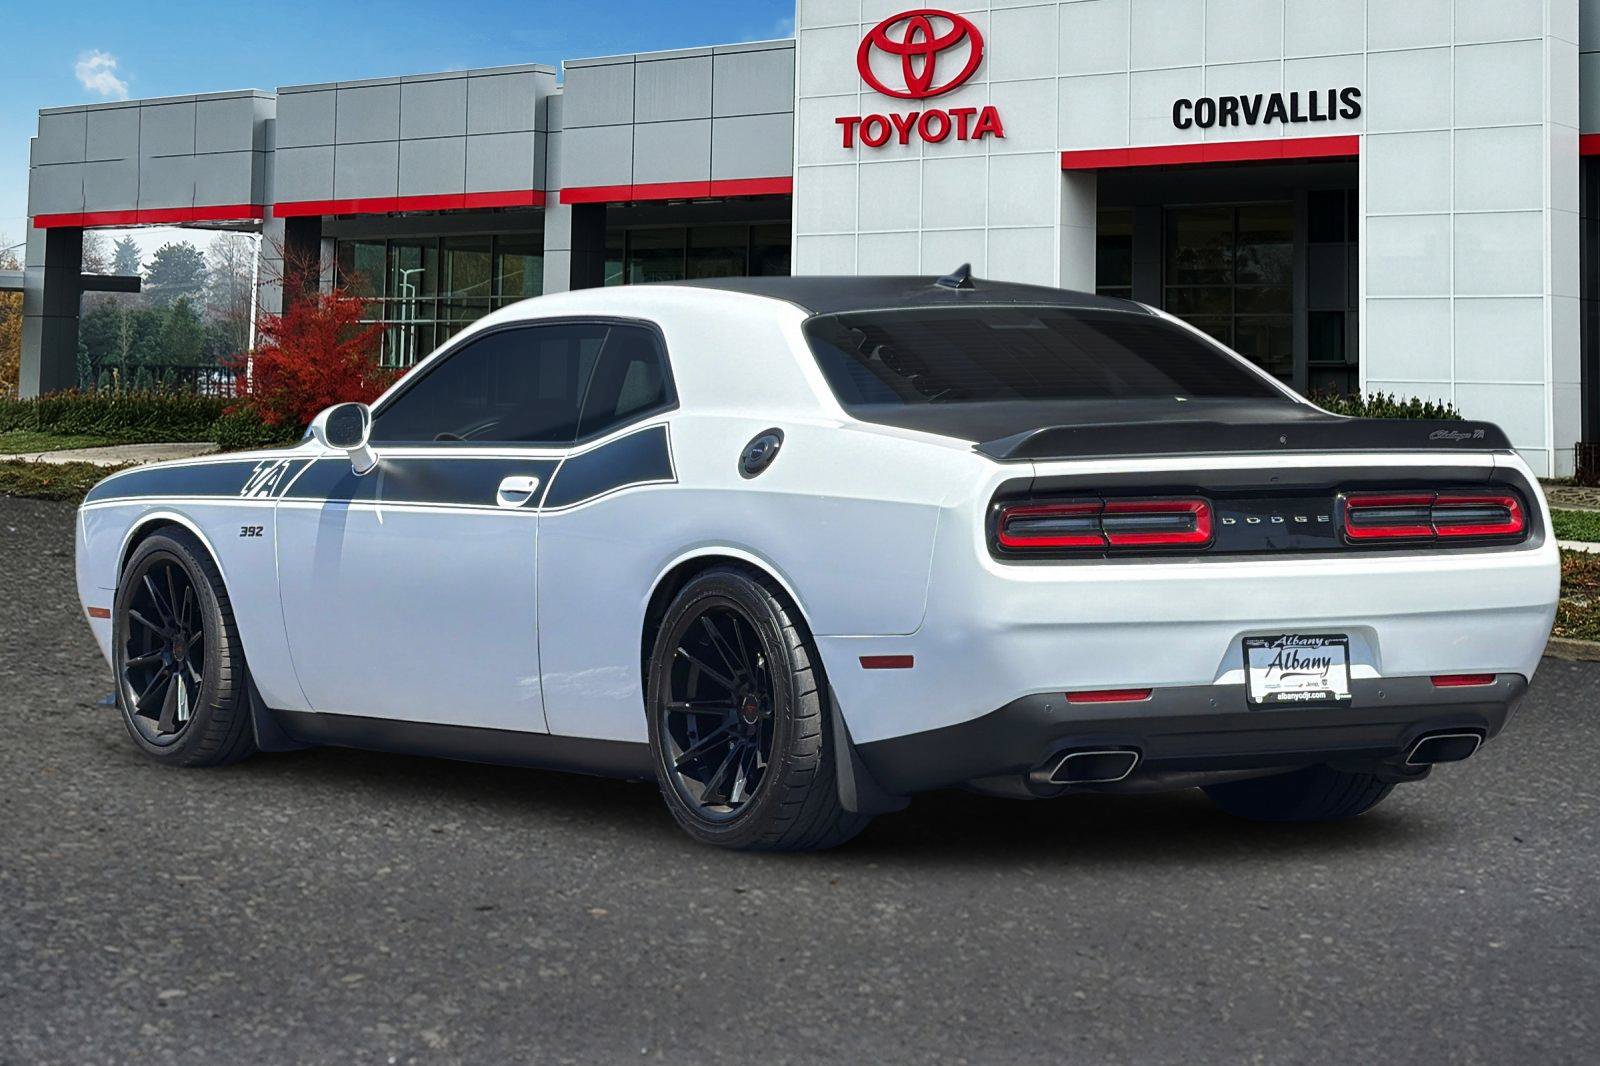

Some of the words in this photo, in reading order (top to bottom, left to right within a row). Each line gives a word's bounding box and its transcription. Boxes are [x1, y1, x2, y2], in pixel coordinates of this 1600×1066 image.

[1173, 87, 1362, 129] CORVALLIS
[835, 106, 1005, 148] TOYOTA
[1222, 515, 1330, 524] DODGE
[240, 526, 263, 537] 392
[1270, 635, 1323, 649] Albany
[1265, 648, 1331, 678] Albany
